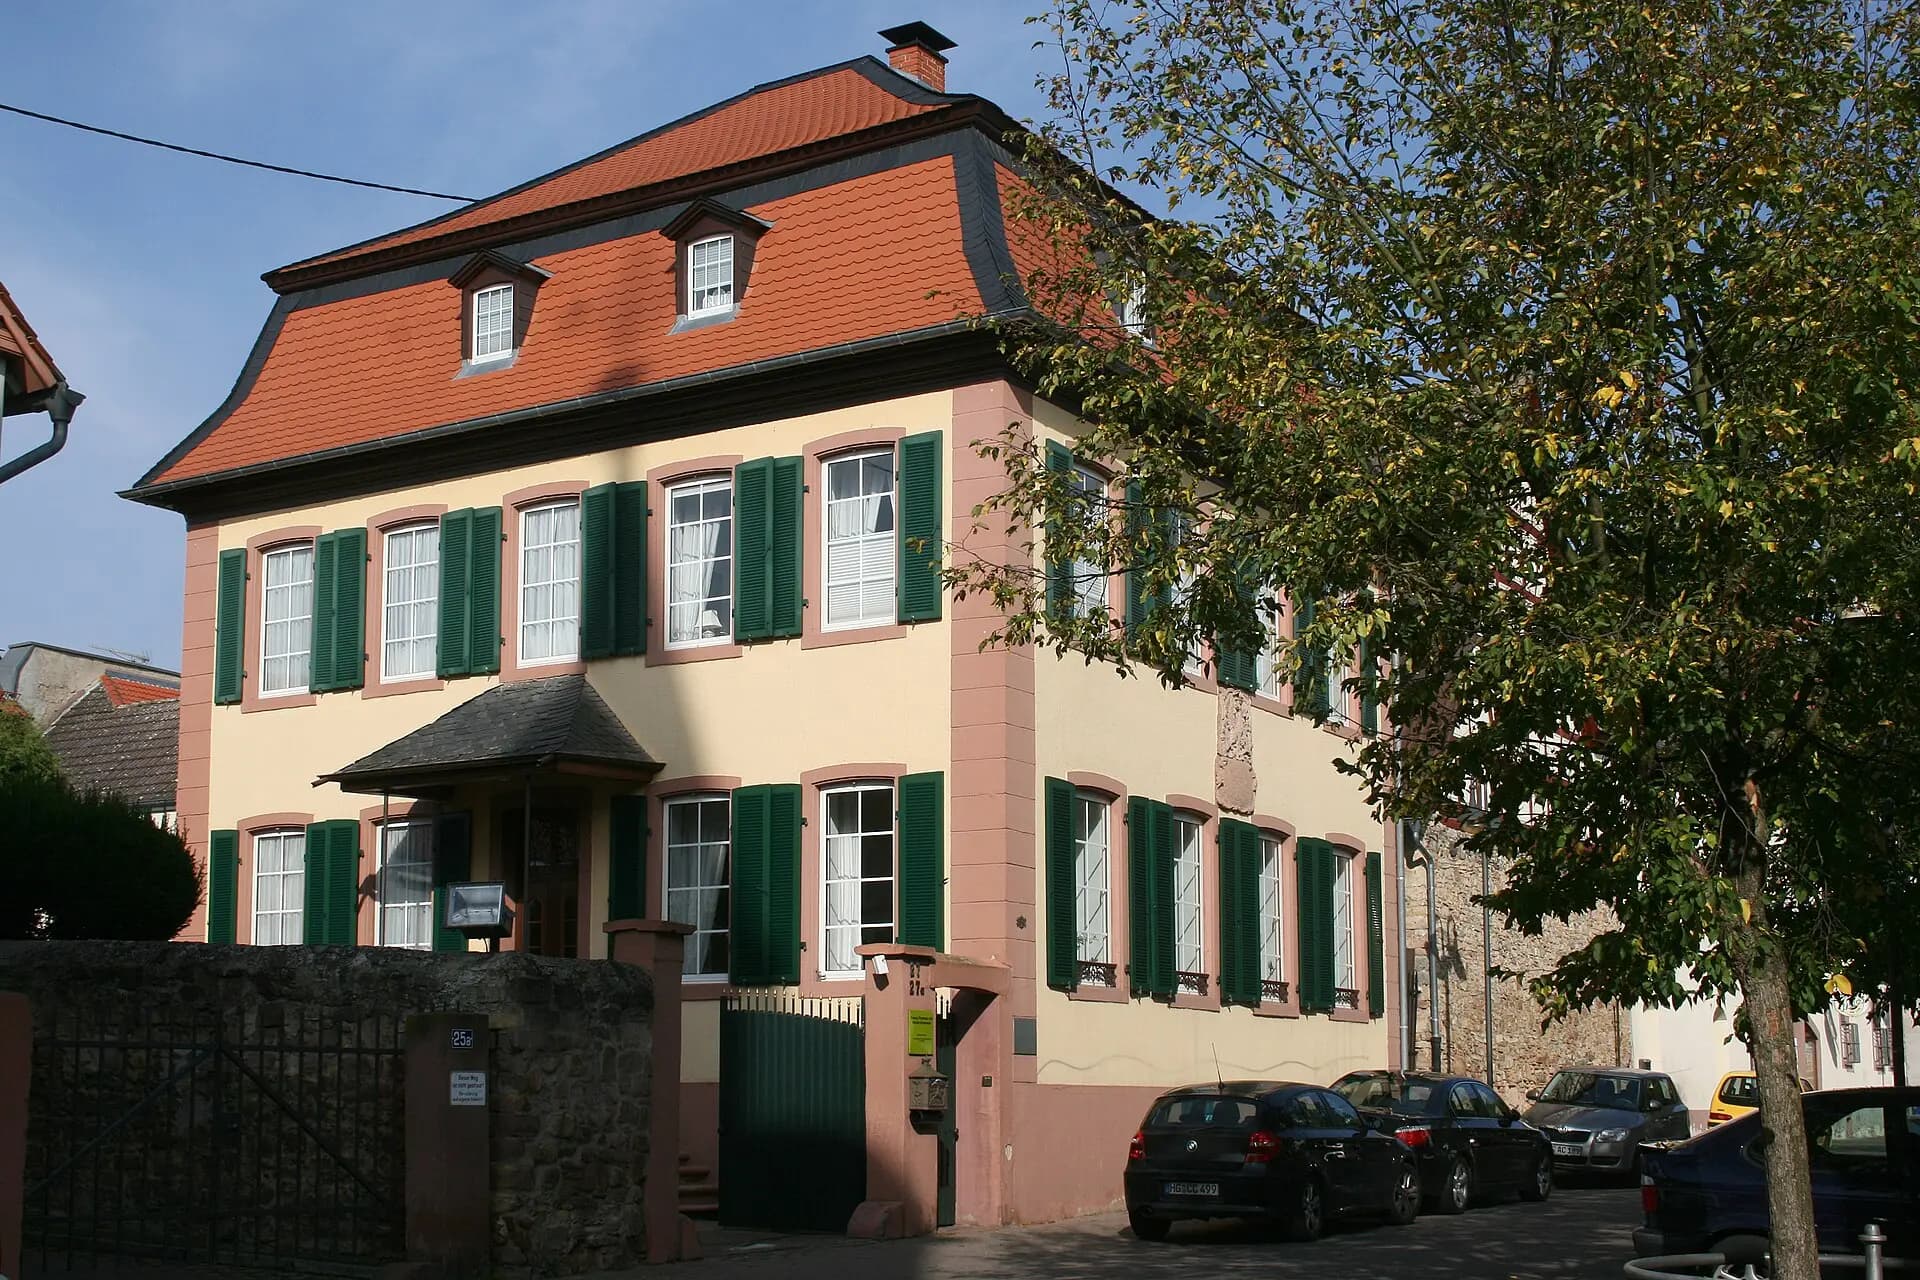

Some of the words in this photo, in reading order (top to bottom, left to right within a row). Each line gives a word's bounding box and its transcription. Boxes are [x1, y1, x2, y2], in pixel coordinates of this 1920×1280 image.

[453, 1031, 471, 1046] 25a
[1169, 1183, 1182, 1193] HG
[1200, 1184, 1217, 1194] 499
